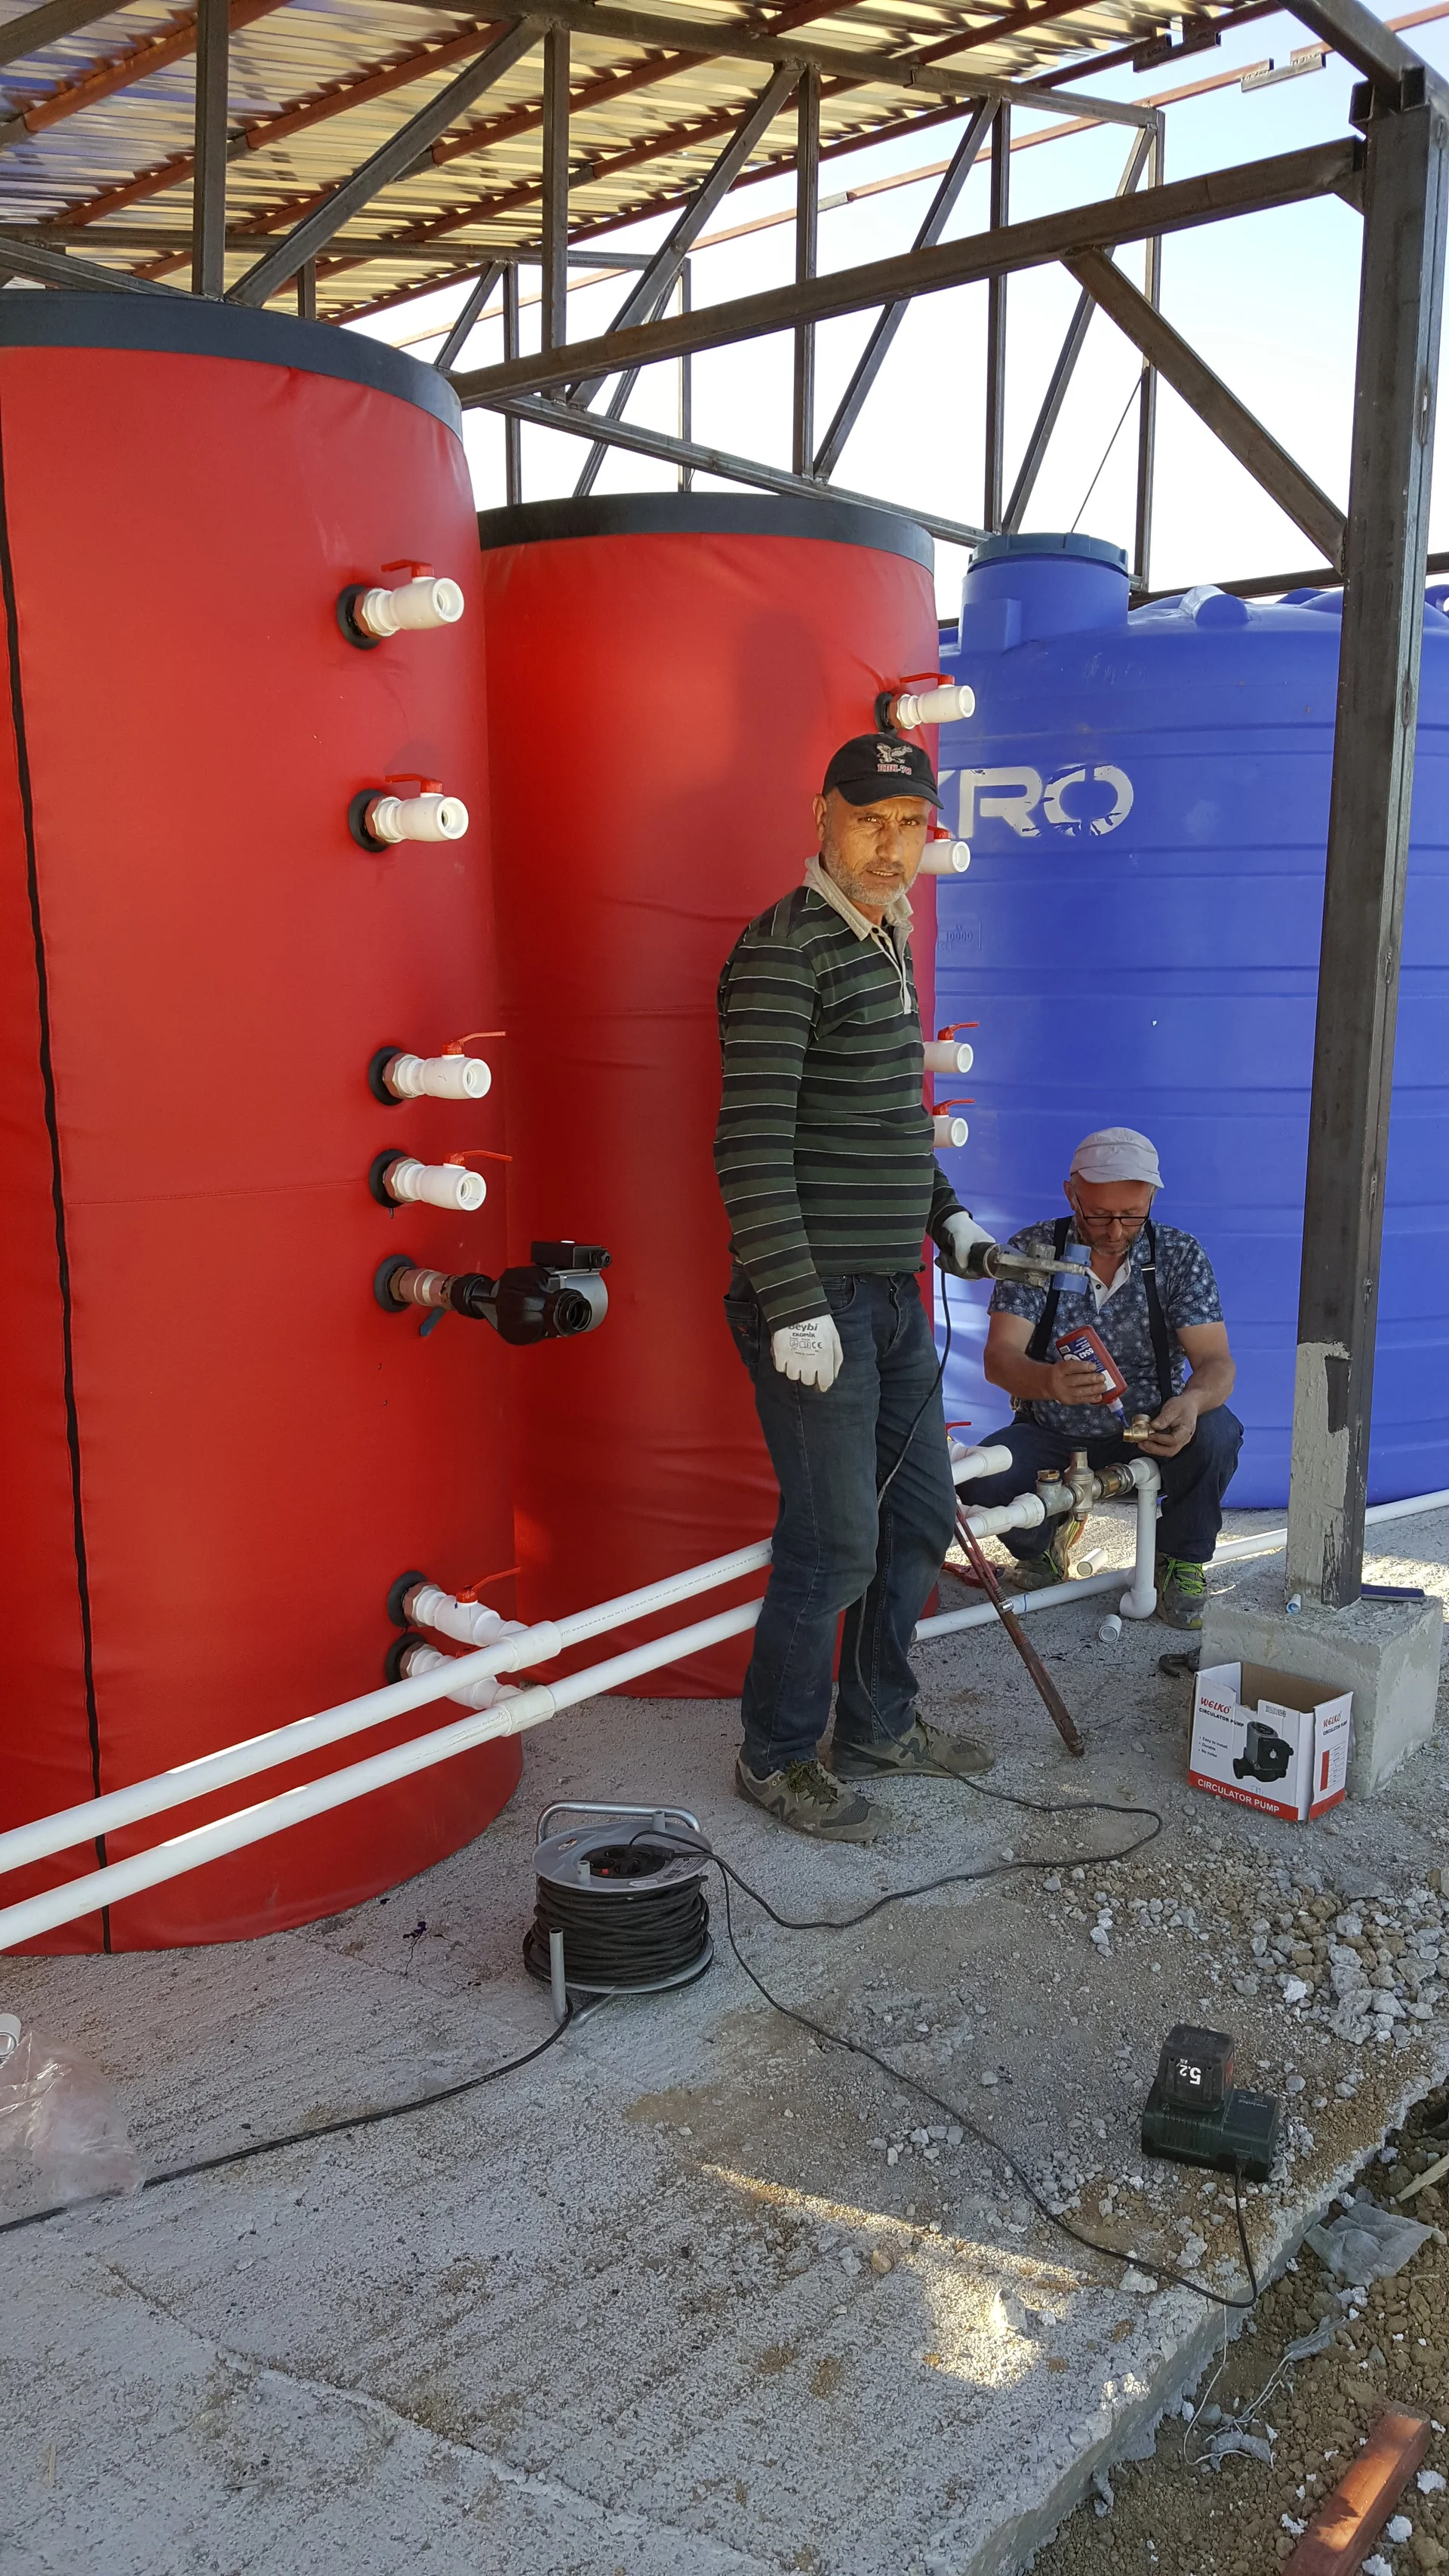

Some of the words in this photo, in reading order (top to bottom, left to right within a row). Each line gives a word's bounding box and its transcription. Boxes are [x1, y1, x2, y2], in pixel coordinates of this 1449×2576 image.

[1201, 1697, 1230, 1714] WELKO
[1198, 1707, 1229, 1723] CIRCULATOR
[1323, 1713, 1341, 1728] WELKO
[1198, 1778, 1252, 1805] CIRCULATOR
[1254, 1799, 1279, 1813] PUMP
[1179, 2064, 1201, 2085] 5.2
